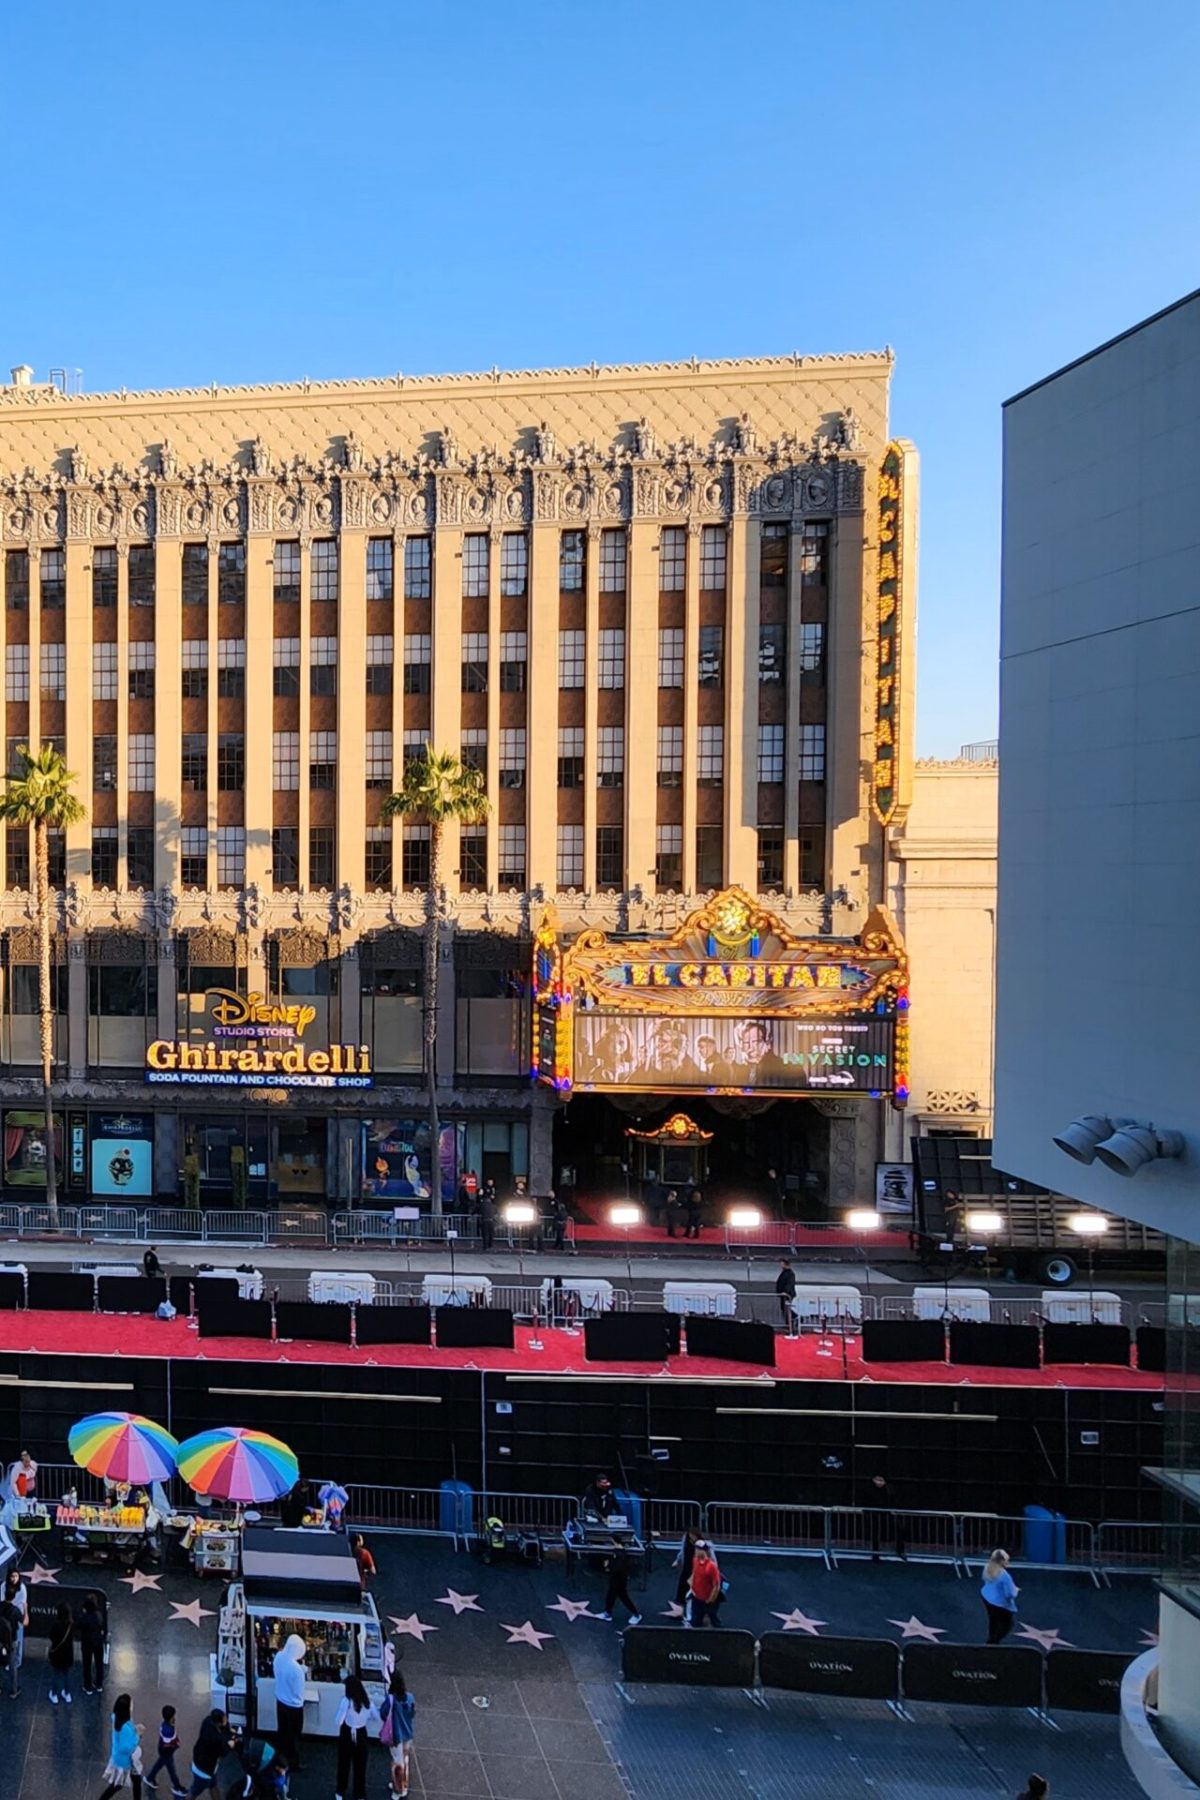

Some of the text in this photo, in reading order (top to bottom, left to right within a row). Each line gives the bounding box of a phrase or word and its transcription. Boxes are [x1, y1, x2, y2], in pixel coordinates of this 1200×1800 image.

[631, 963, 841, 987] EL CAPITAN
[214, 1026, 296, 1037] STUDIO STORE
[812, 1045, 855, 1053] SECRET
[147, 1040, 371, 1073] Ghirardelli
[783, 1053, 887, 1067] INVASION
[149, 1073, 371, 1087] SODA FOUNTAIN AND CHOCOLATE SHOP
[669, 1652, 711, 1662] OVATION
[810, 1661, 853, 1671] OVATION
[952, 1670, 997, 1680] OVATION
